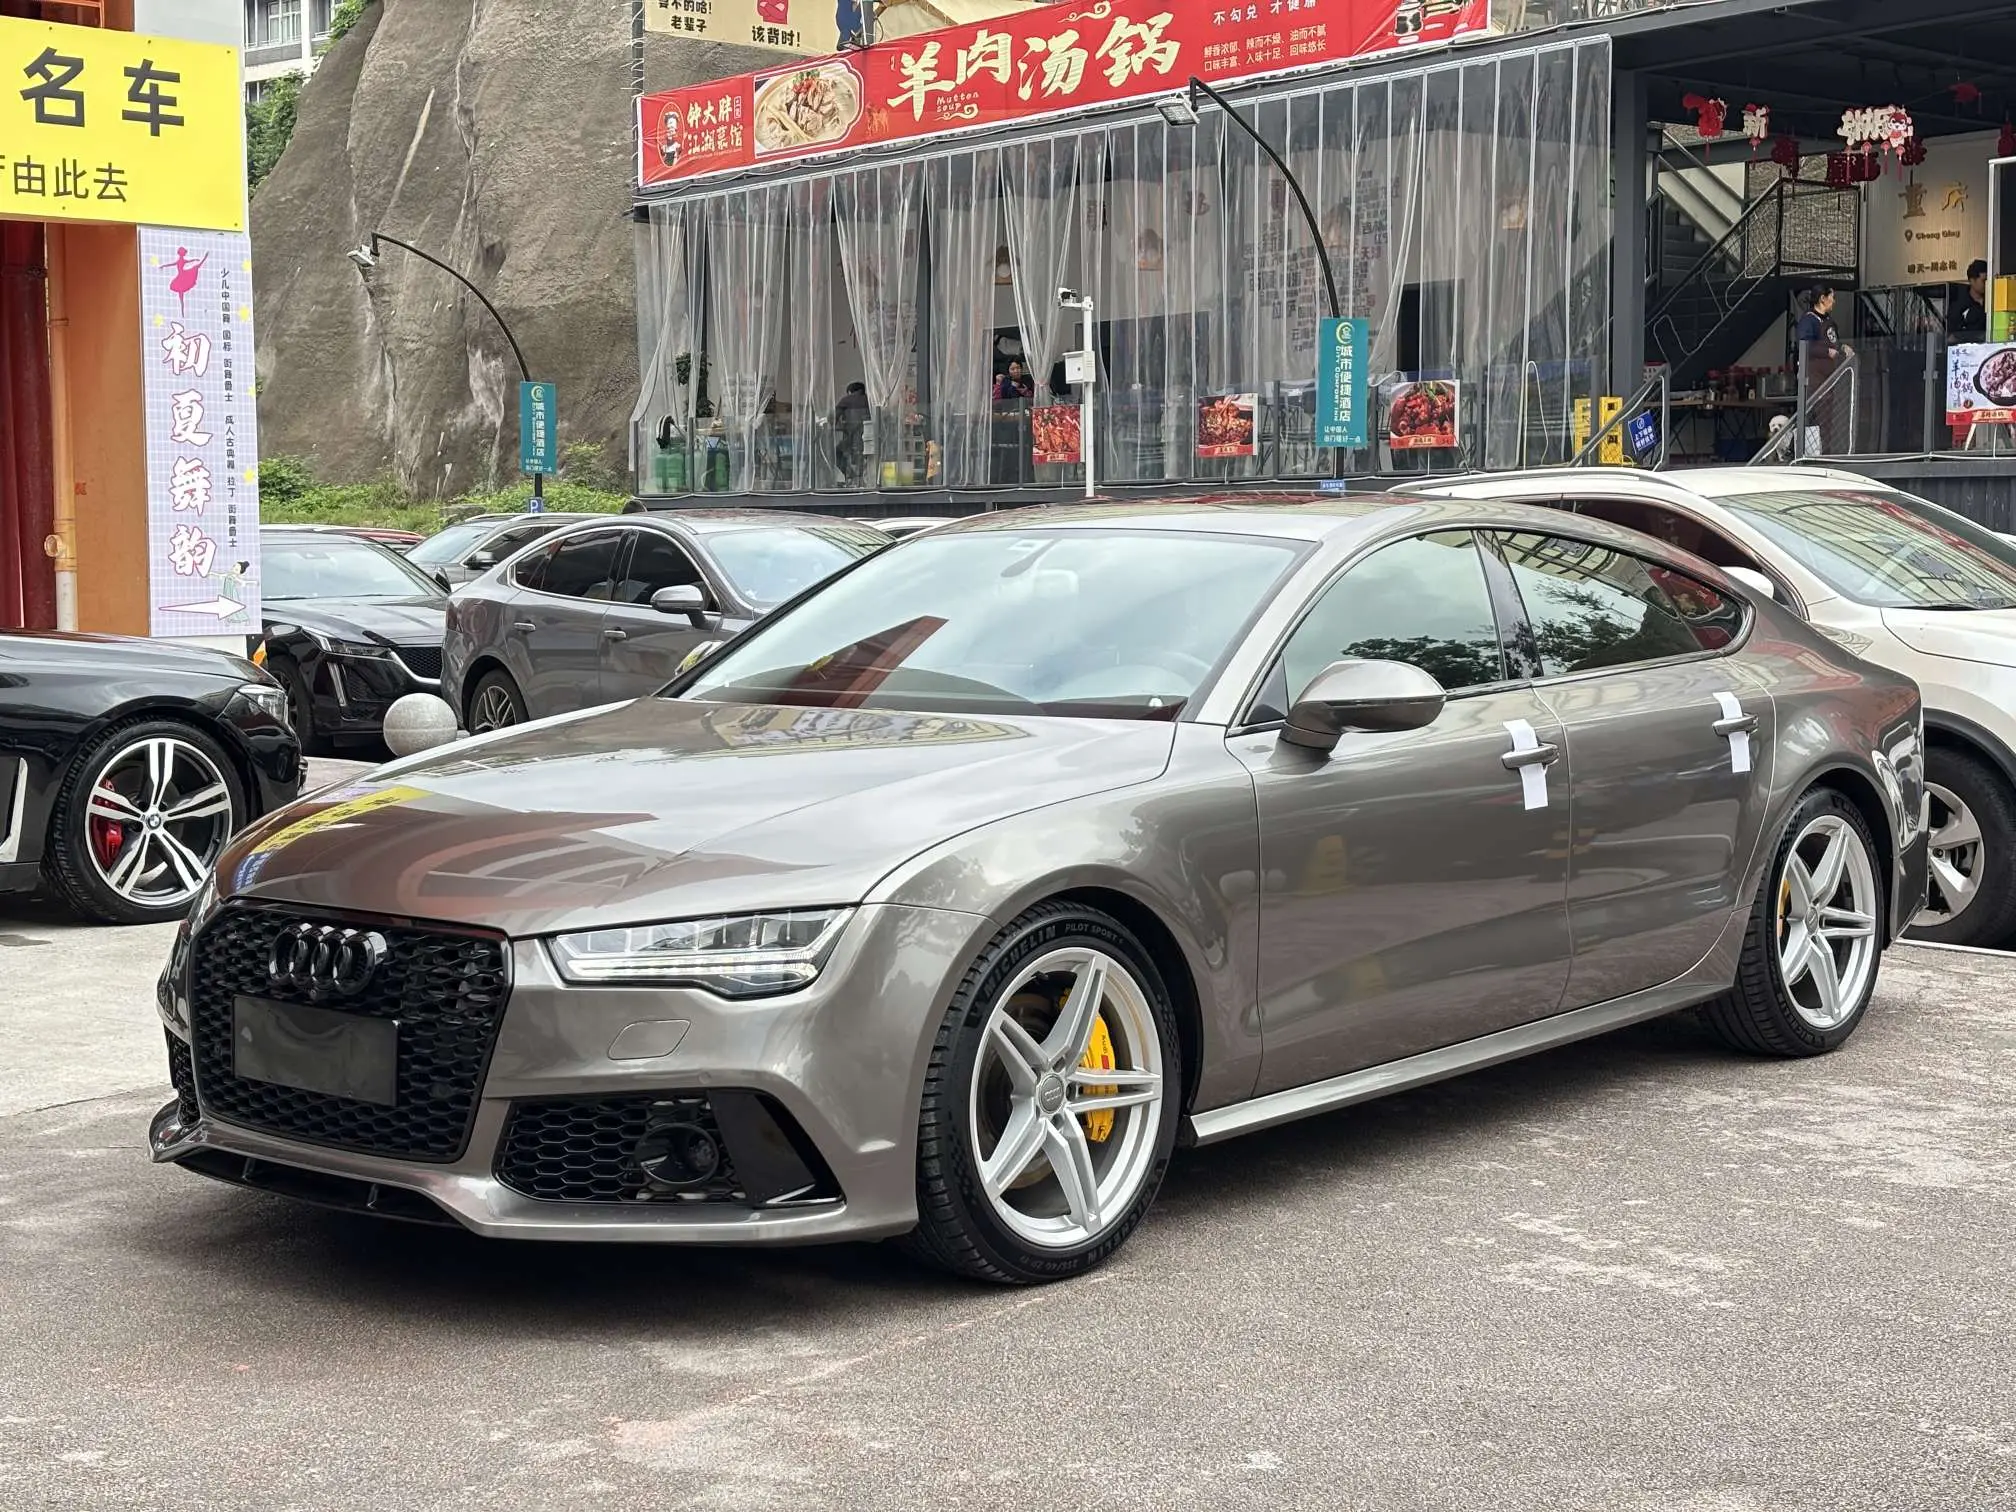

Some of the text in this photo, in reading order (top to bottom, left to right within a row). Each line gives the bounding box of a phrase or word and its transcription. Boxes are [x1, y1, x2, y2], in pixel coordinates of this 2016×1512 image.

[670, 15, 707, 33] 老辈子
[1213, 4, 1258, 25] 不勾兑
[752, 26, 801, 47] 该背时!
[887, 12, 1181, 121] 羊肉汤锅
[20, 46, 185, 137] 名车
[687, 94, 733, 129] 钟大胖
[937, 91, 979, 105] Mutton
[688, 122, 744, 155] 江湖菜馆
[0, 154, 128, 203] 由此去
[1340, 345, 1353, 421] 城市便捷酒店
[160, 322, 218, 578] 初夏舞韵
[982, 925, 1057, 998] MICHELIN
[1065, 922, 1089, 934] PILOT
[1091, 925, 1118, 941] SPORT
